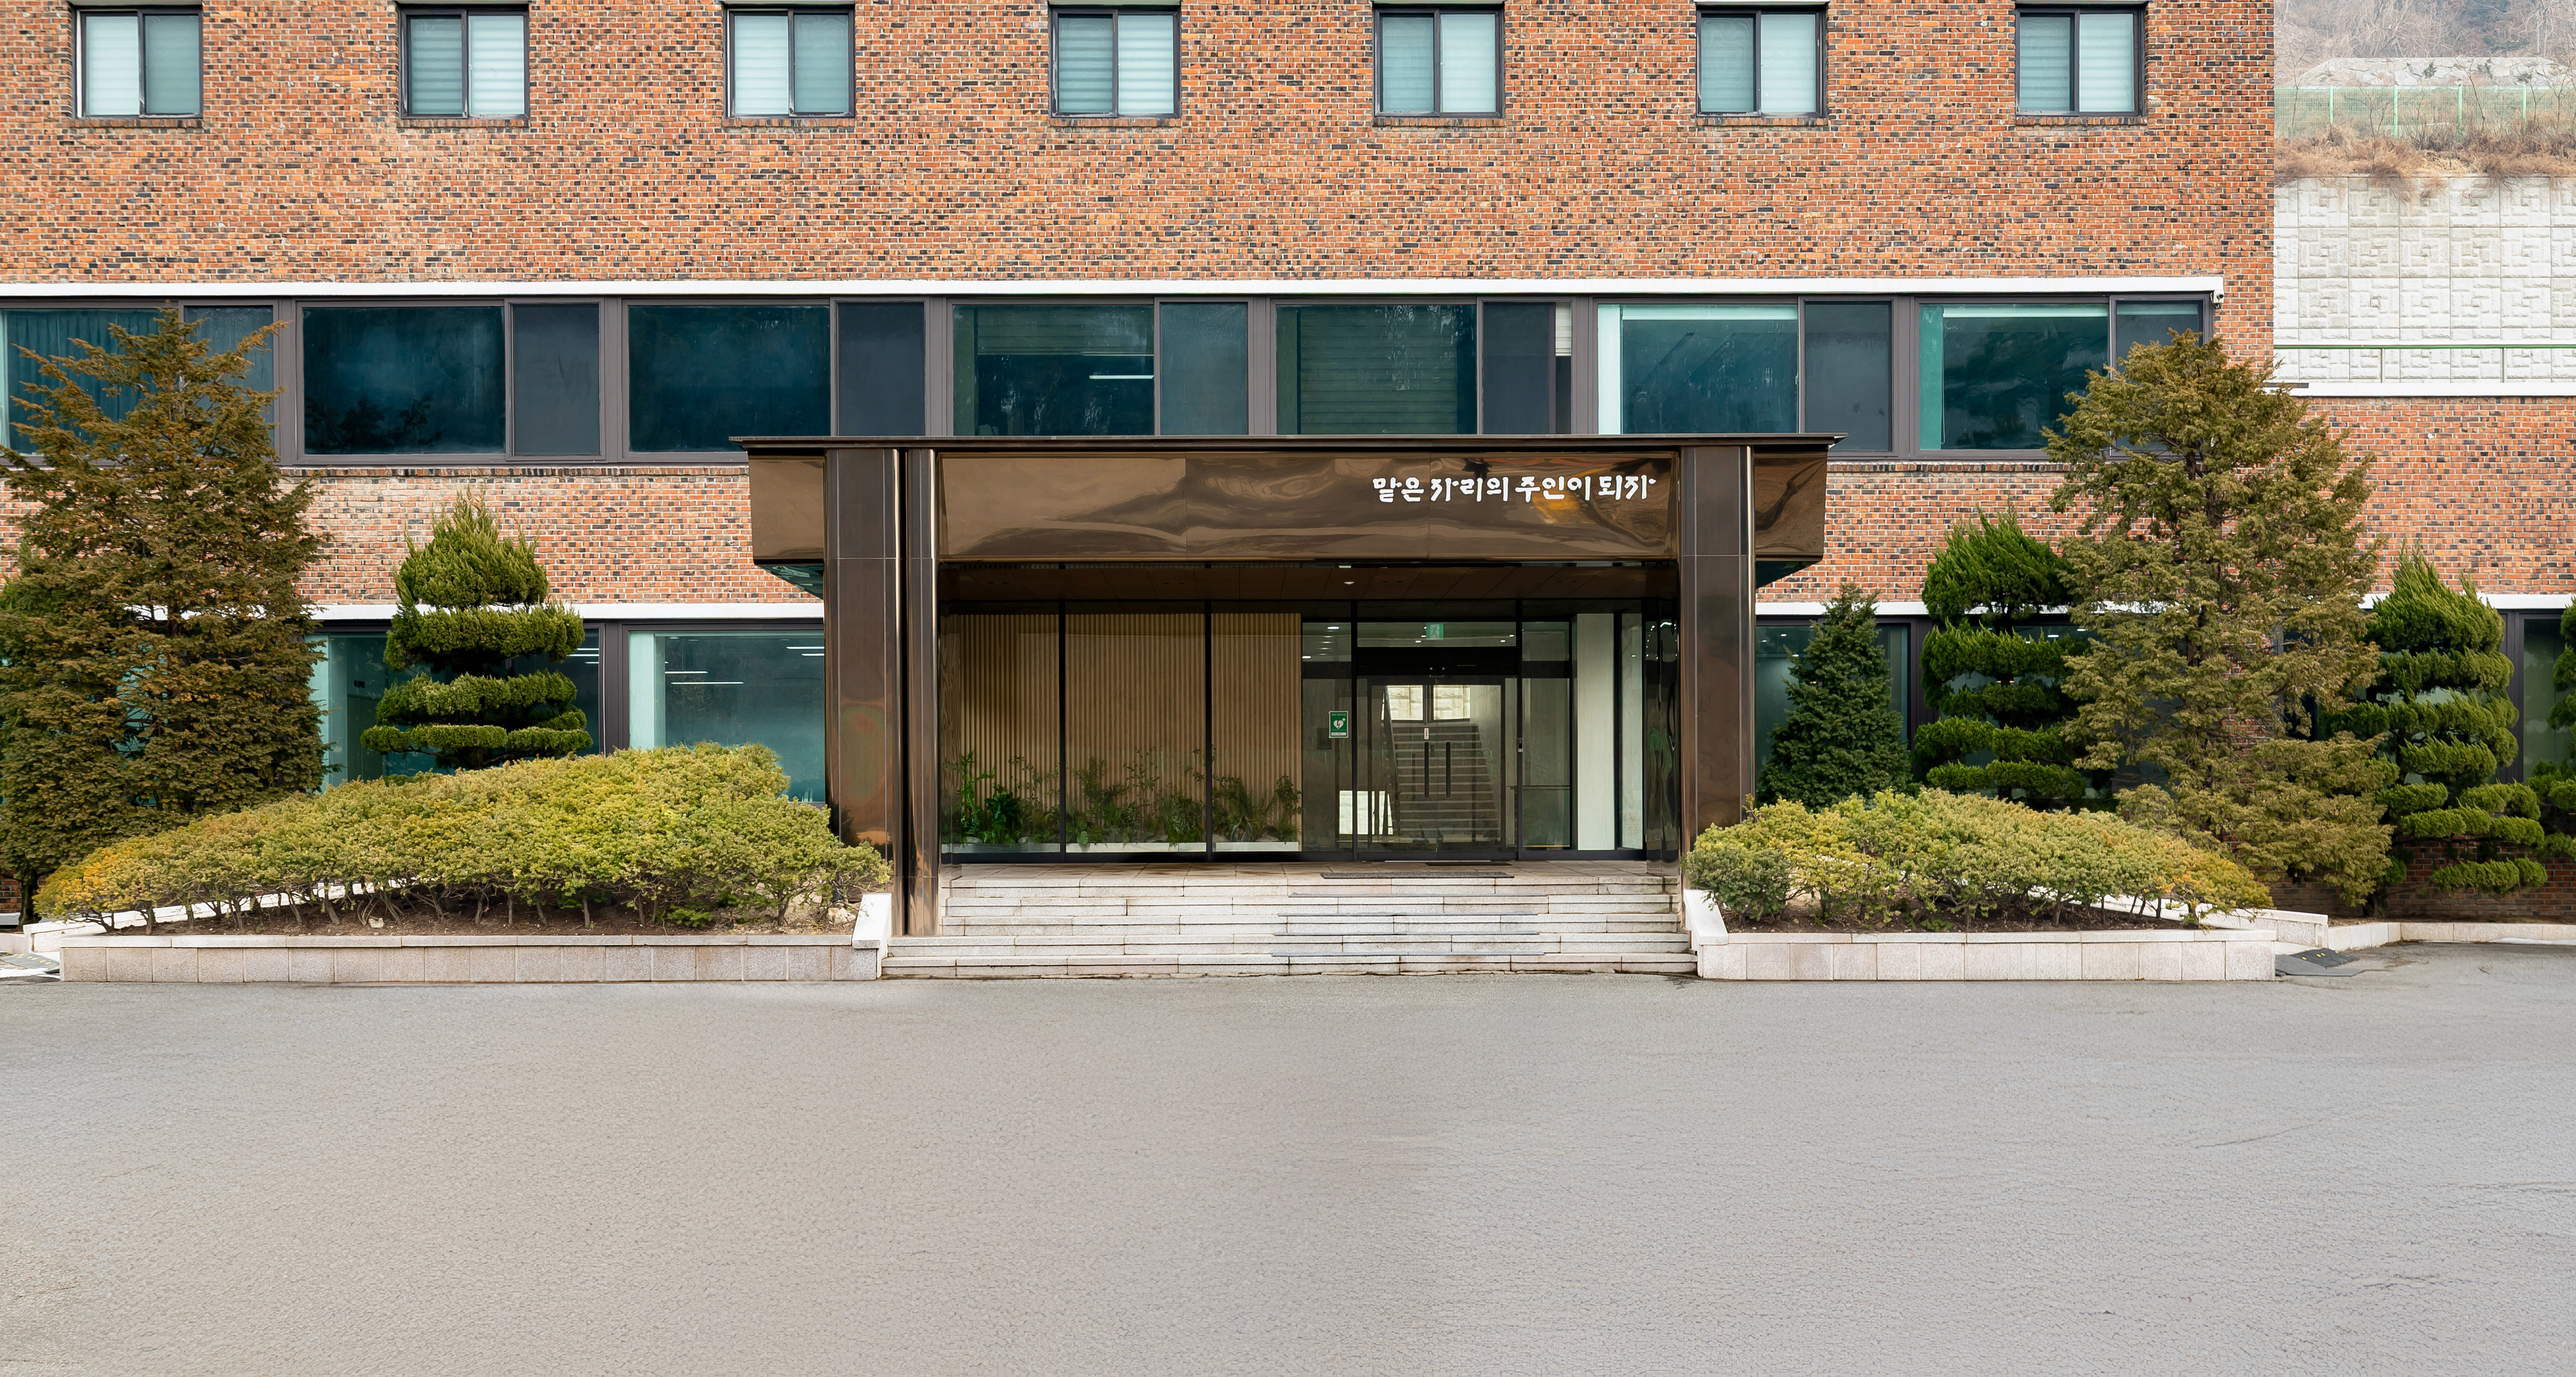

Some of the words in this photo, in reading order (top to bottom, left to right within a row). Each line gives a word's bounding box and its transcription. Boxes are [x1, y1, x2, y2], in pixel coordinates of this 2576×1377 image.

[1373, 477, 1424, 502] 맡은
[1431, 477, 1509, 502] 자리의
[1515, 476, 1591, 503] 주인이
[1598, 474, 1656, 500] 되자
